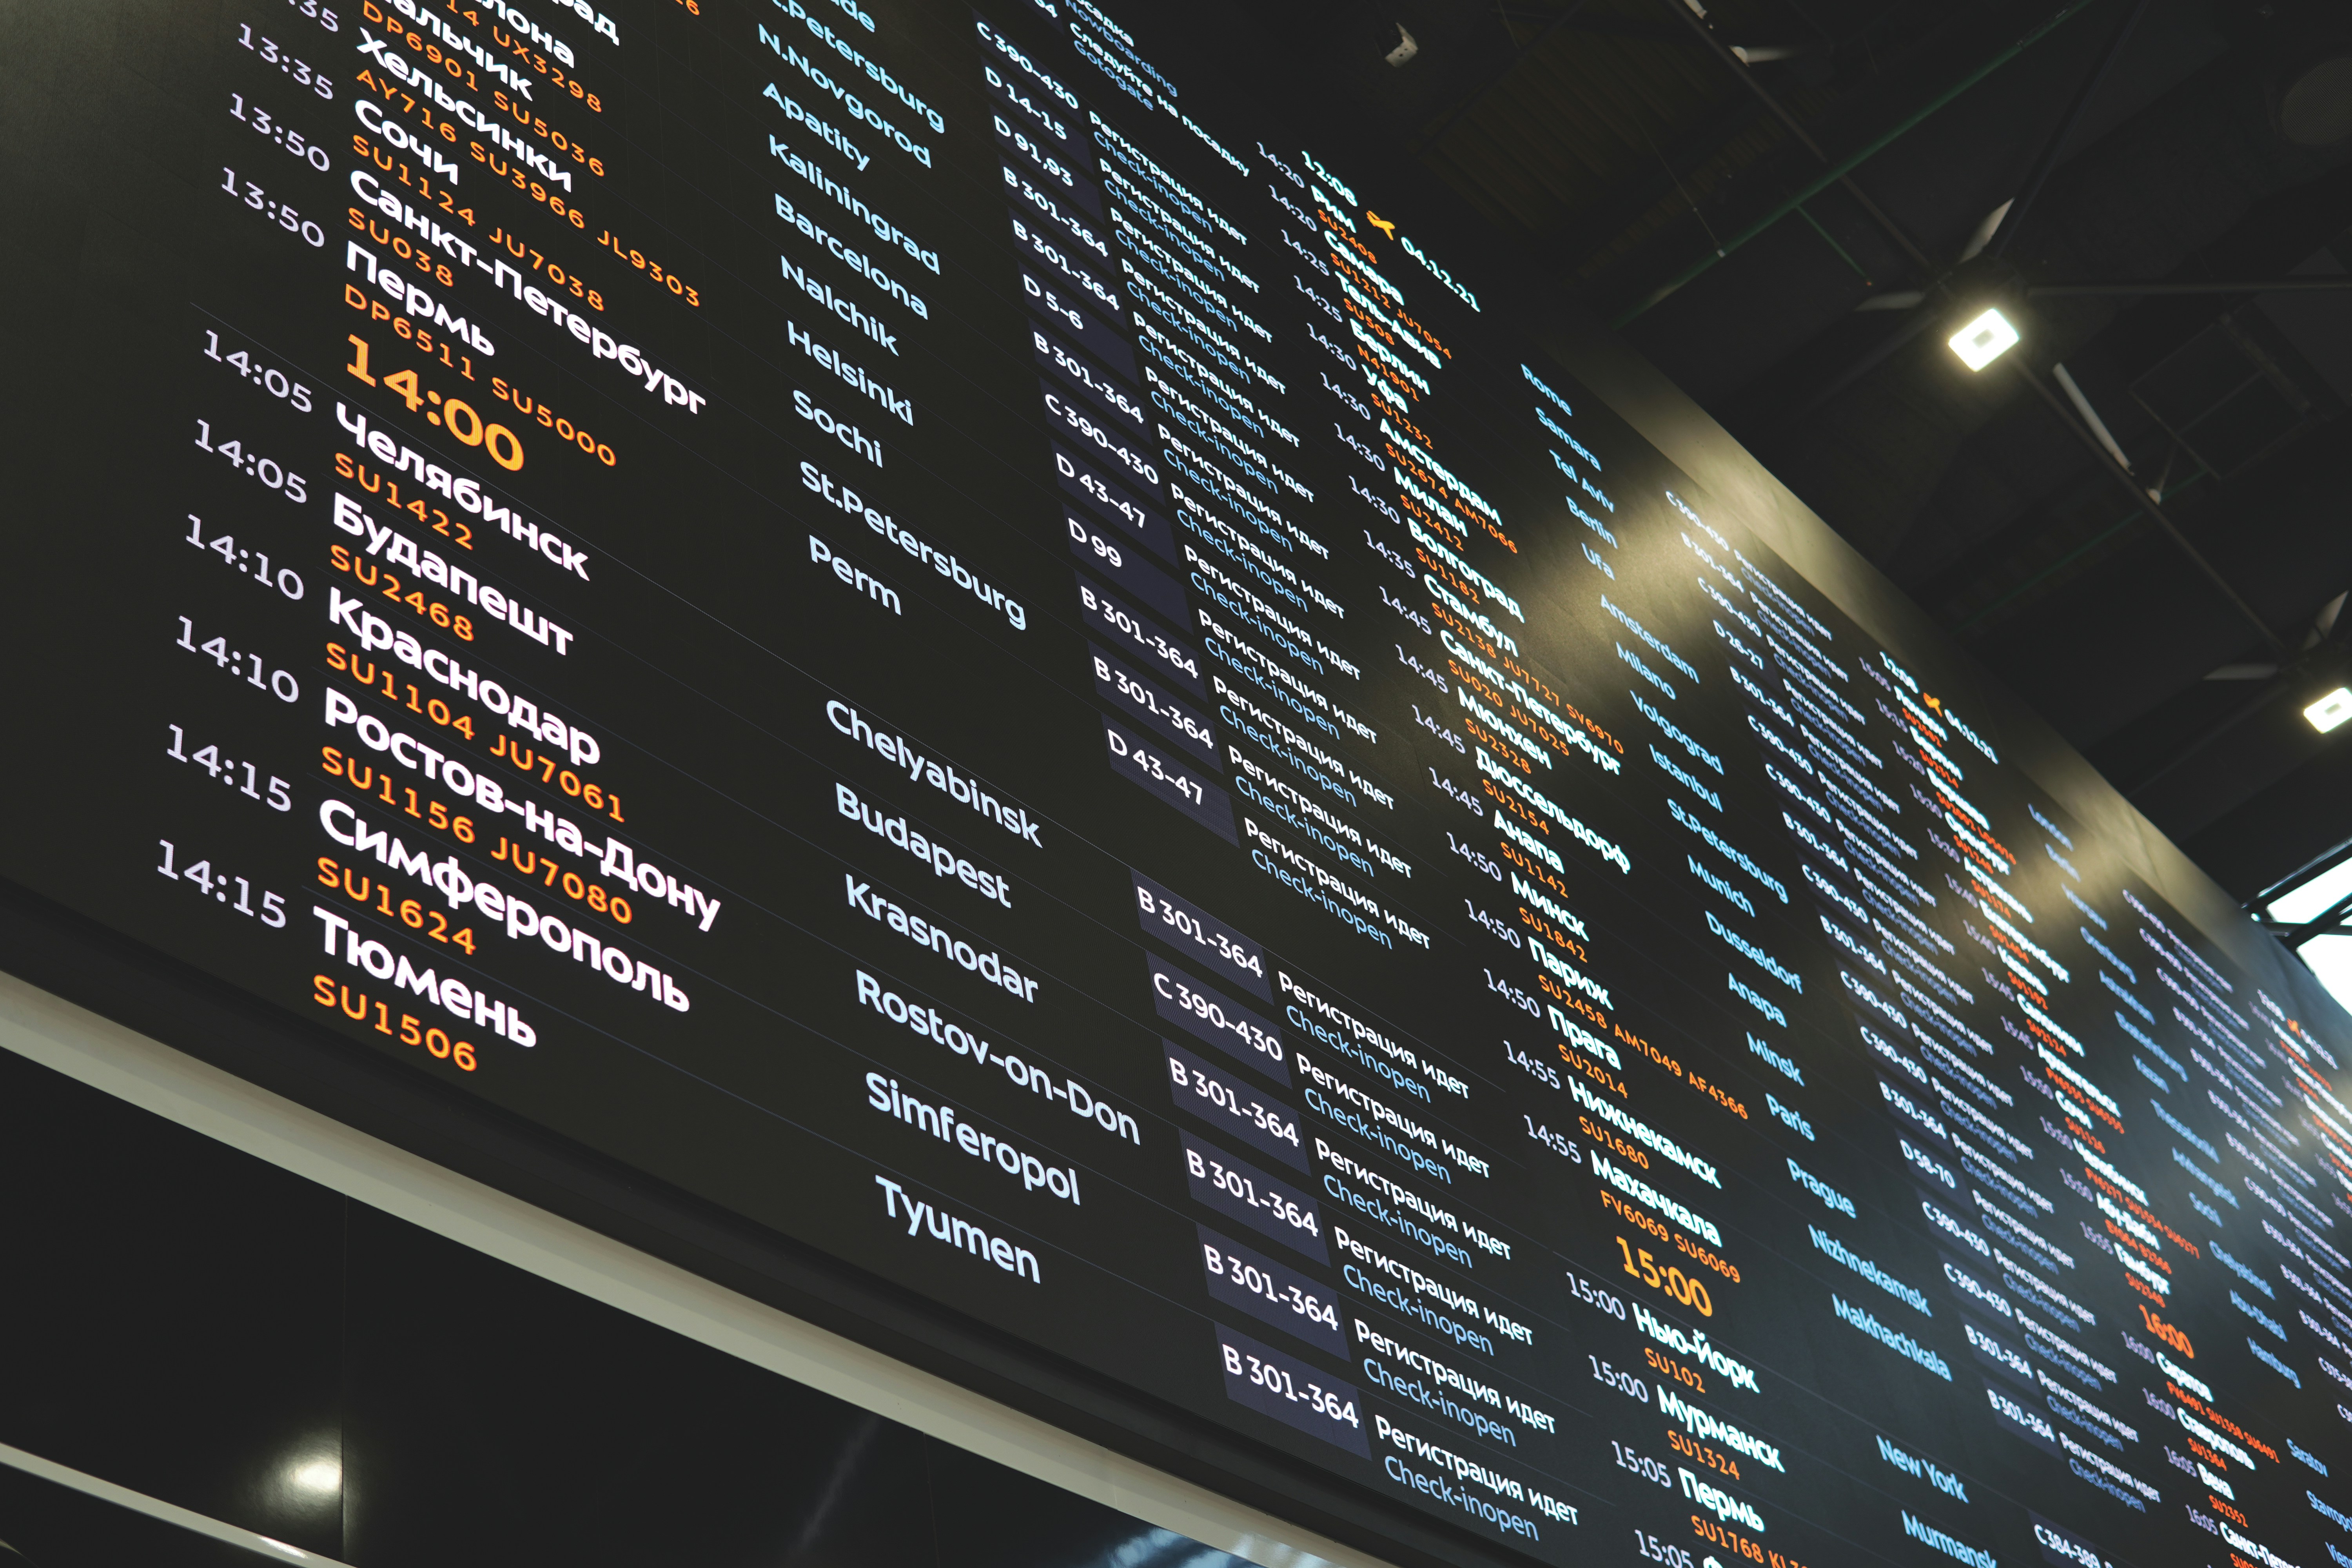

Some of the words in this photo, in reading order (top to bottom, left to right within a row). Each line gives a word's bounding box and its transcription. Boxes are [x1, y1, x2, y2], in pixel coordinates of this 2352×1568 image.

[238, 23, 333, 99] 13:35
[364, 0, 478, 91] DP6901
[494, 91, 604, 176] SU5036
[385, 0, 532, 101] альчик
[494, 26, 601, 112] UX3298
[773, 0, 944, 133] .Petersburg
[230, 93, 329, 171] 13:50
[357, 27, 571, 192] Хельсинки
[759, 24, 931, 168] N.Novgorod
[763, 83, 870, 171] Apatity
[1070, 23, 1153, 97] Следуйте
[1157, 95, 1179, 118] на
[1181, 115, 1249, 177] посадку
[355, 100, 458, 185] Сочи
[1089, 111, 1203, 211] Регистрация
[1207, 208, 1247, 245] идет
[1257, 142, 1304, 188] 14:20
[222, 167, 324, 247] 13:50
[353, 135, 475, 226] SU1124
[489, 228, 604, 311] JU7038
[357, 70, 456, 142] AY716
[470, 142, 584, 229] SU3966
[597, 230, 699, 307] JL9303
[769, 134, 940, 275] Kaliningrad
[1301, 151, 1358, 207] 12:08
[1401, 236, 1481, 312] 04.12.21
[1311, 185, 1356, 233] Рим
[349, 208, 453, 287] SU038
[775, 194, 928, 319] Barcelona
[1324, 230, 1404, 305] Самара
[347, 241, 495, 356] Пермь
[350, 171, 706, 414] Санкт-Петербург
[781, 256, 898, 356] Nalchik
[204, 330, 312, 412] 14:05
[345, 284, 475, 381] DP6511
[492, 377, 616, 466] SU5000
[788, 321, 913, 426] Helsinki
[1350, 318, 1430, 395] Берлин
[1357, 345, 1419, 401] N41901
[1361, 364, 1408, 413] Уфа
[1521, 364, 1572, 416] Rome
[347, 334, 524, 471] 14:00
[793, 390, 882, 468] Sochi
[195, 419, 307, 503] 14:05
[336, 402, 590, 581] Челябинск
[336, 453, 473, 550] SU1422
[1380, 418, 1502, 526] Амстердам
[1394, 467, 1468, 537] Милан
[186, 514, 303, 600] 14:10
[334, 492, 573, 655] Будапешт
[800, 462, 1026, 630] St.Petersburg
[809, 535, 901, 615] Perm
[1581, 542, 1615, 581] Ufa
[331, 545, 474, 641] SU2468
[1424, 574, 1518, 657] Стамбул
[177, 616, 298, 702] 14:10
[330, 587, 600, 766] Краснодар
[167, 724, 291, 811] 14:15
[327, 642, 475, 740] SU1104
[490, 735, 624, 822] JU7061
[1458, 686, 1552, 769] Мюнхен
[325, 687, 720, 932] Ростов-на-Дону
[827, 701, 1042, 848] Chelyabinsk
[1475, 746, 1630, 874] Дюссельдорф
[1483, 779, 1549, 835] SU2154
[1649, 744, 1722, 812] Istanbul
[322, 746, 475, 843] SU1156
[491, 837, 632, 924] JU7080
[836, 783, 1011, 908] Budapest
[1447, 832, 1502, 881] 14:50
[1494, 810, 1564, 874] Анапа
[158, 840, 286, 928] 14:15
[318, 857, 476, 955] SU1624
[319, 800, 690, 1012] Симферополь
[1511, 872, 1589, 942] Минск
[1688, 855, 1755, 917] Munich
[313, 906, 537, 1047] Тюмень
[846, 874, 1038, 1003] Krasnodar
[1528, 936, 1613, 1010] Париж
[314, 975, 477, 1071] SU1506
[857, 969, 1140, 1145] Rostov-on-Don
[1504, 1040, 1560, 1089] 14:55
[1538, 975, 1607, 1029] SU2458
[1615, 1024, 1682, 1076] AM7049
[1690, 1072, 1748, 1119] AF4366
[1548, 1005, 1621, 1070] Прага
[1747, 1032, 1804, 1086] Minsk
[1559, 1044, 1628, 1098] SU2014
[866, 1073, 1080, 1205] Simferopol
[1296, 1053, 1437, 1149] Регистрация
[1442, 1140, 1489, 1178] идет
[1568, 1075, 1722, 1189] Нижнекамск
[1766, 1093, 1815, 1141] Paris
[875, 1175, 1040, 1283] Tyumen
[1591, 1150, 1722, 1247] Махачкала
[1787, 1158, 1856, 1218] Prague
[1601, 1190, 1668, 1241] FV6069
[1674, 1234, 1740, 1283] SU6069
[1616, 1236, 1712, 1316] 15:00
[1808, 1224, 1932, 1317] Nizhnekamsk
[1566, 1272, 1626, 1320] 15:00
[1832, 1294, 1952, 1381] Makhachkala
[2139, 1304, 2194, 1359] 16:00
[1632, 1303, 1760, 1393] Нью-Йорк
[1645, 1348, 1705, 1393] SU102
[1375, 1415, 1524, 1501] Регистрация
[1528, 1488, 1577, 1525] идет
[1612, 1441, 1671, 1488] 15:05
[1657, 1385, 1785, 1473] Мурманск
[1668, 1430, 1739, 1480] SU1324
[1876, 1435, 1921, 1478] New
[1922, 1459, 1969, 1503] York
[1678, 1467, 1765, 1532] Пермь
[1691, 1515, 1764, 1563] SU1768
